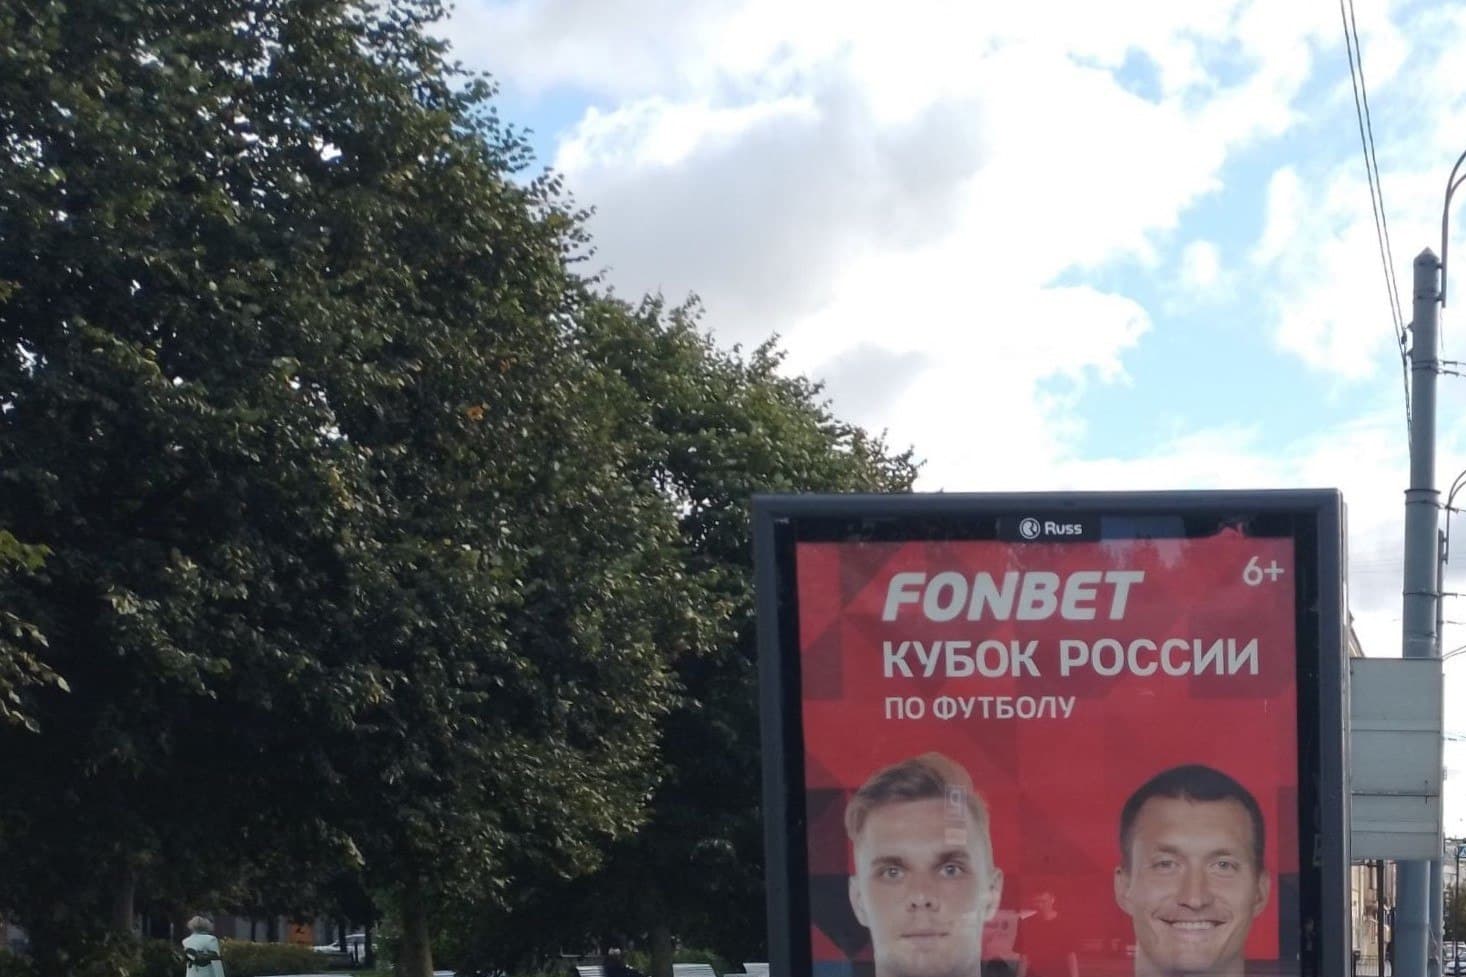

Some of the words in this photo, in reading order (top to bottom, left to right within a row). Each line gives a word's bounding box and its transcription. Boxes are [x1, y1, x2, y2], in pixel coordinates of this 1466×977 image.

[1044, 521, 1083, 535] Russ
[1243, 556, 1284, 586] 6+
[882, 570, 1145, 622] FONBET
[883, 640, 1040, 678] КУБОК
[1059, 638, 1259, 677] РОССИИ
[885, 696, 925, 720] ПО
[932, 696, 1076, 721] ФУТБОЛУ
